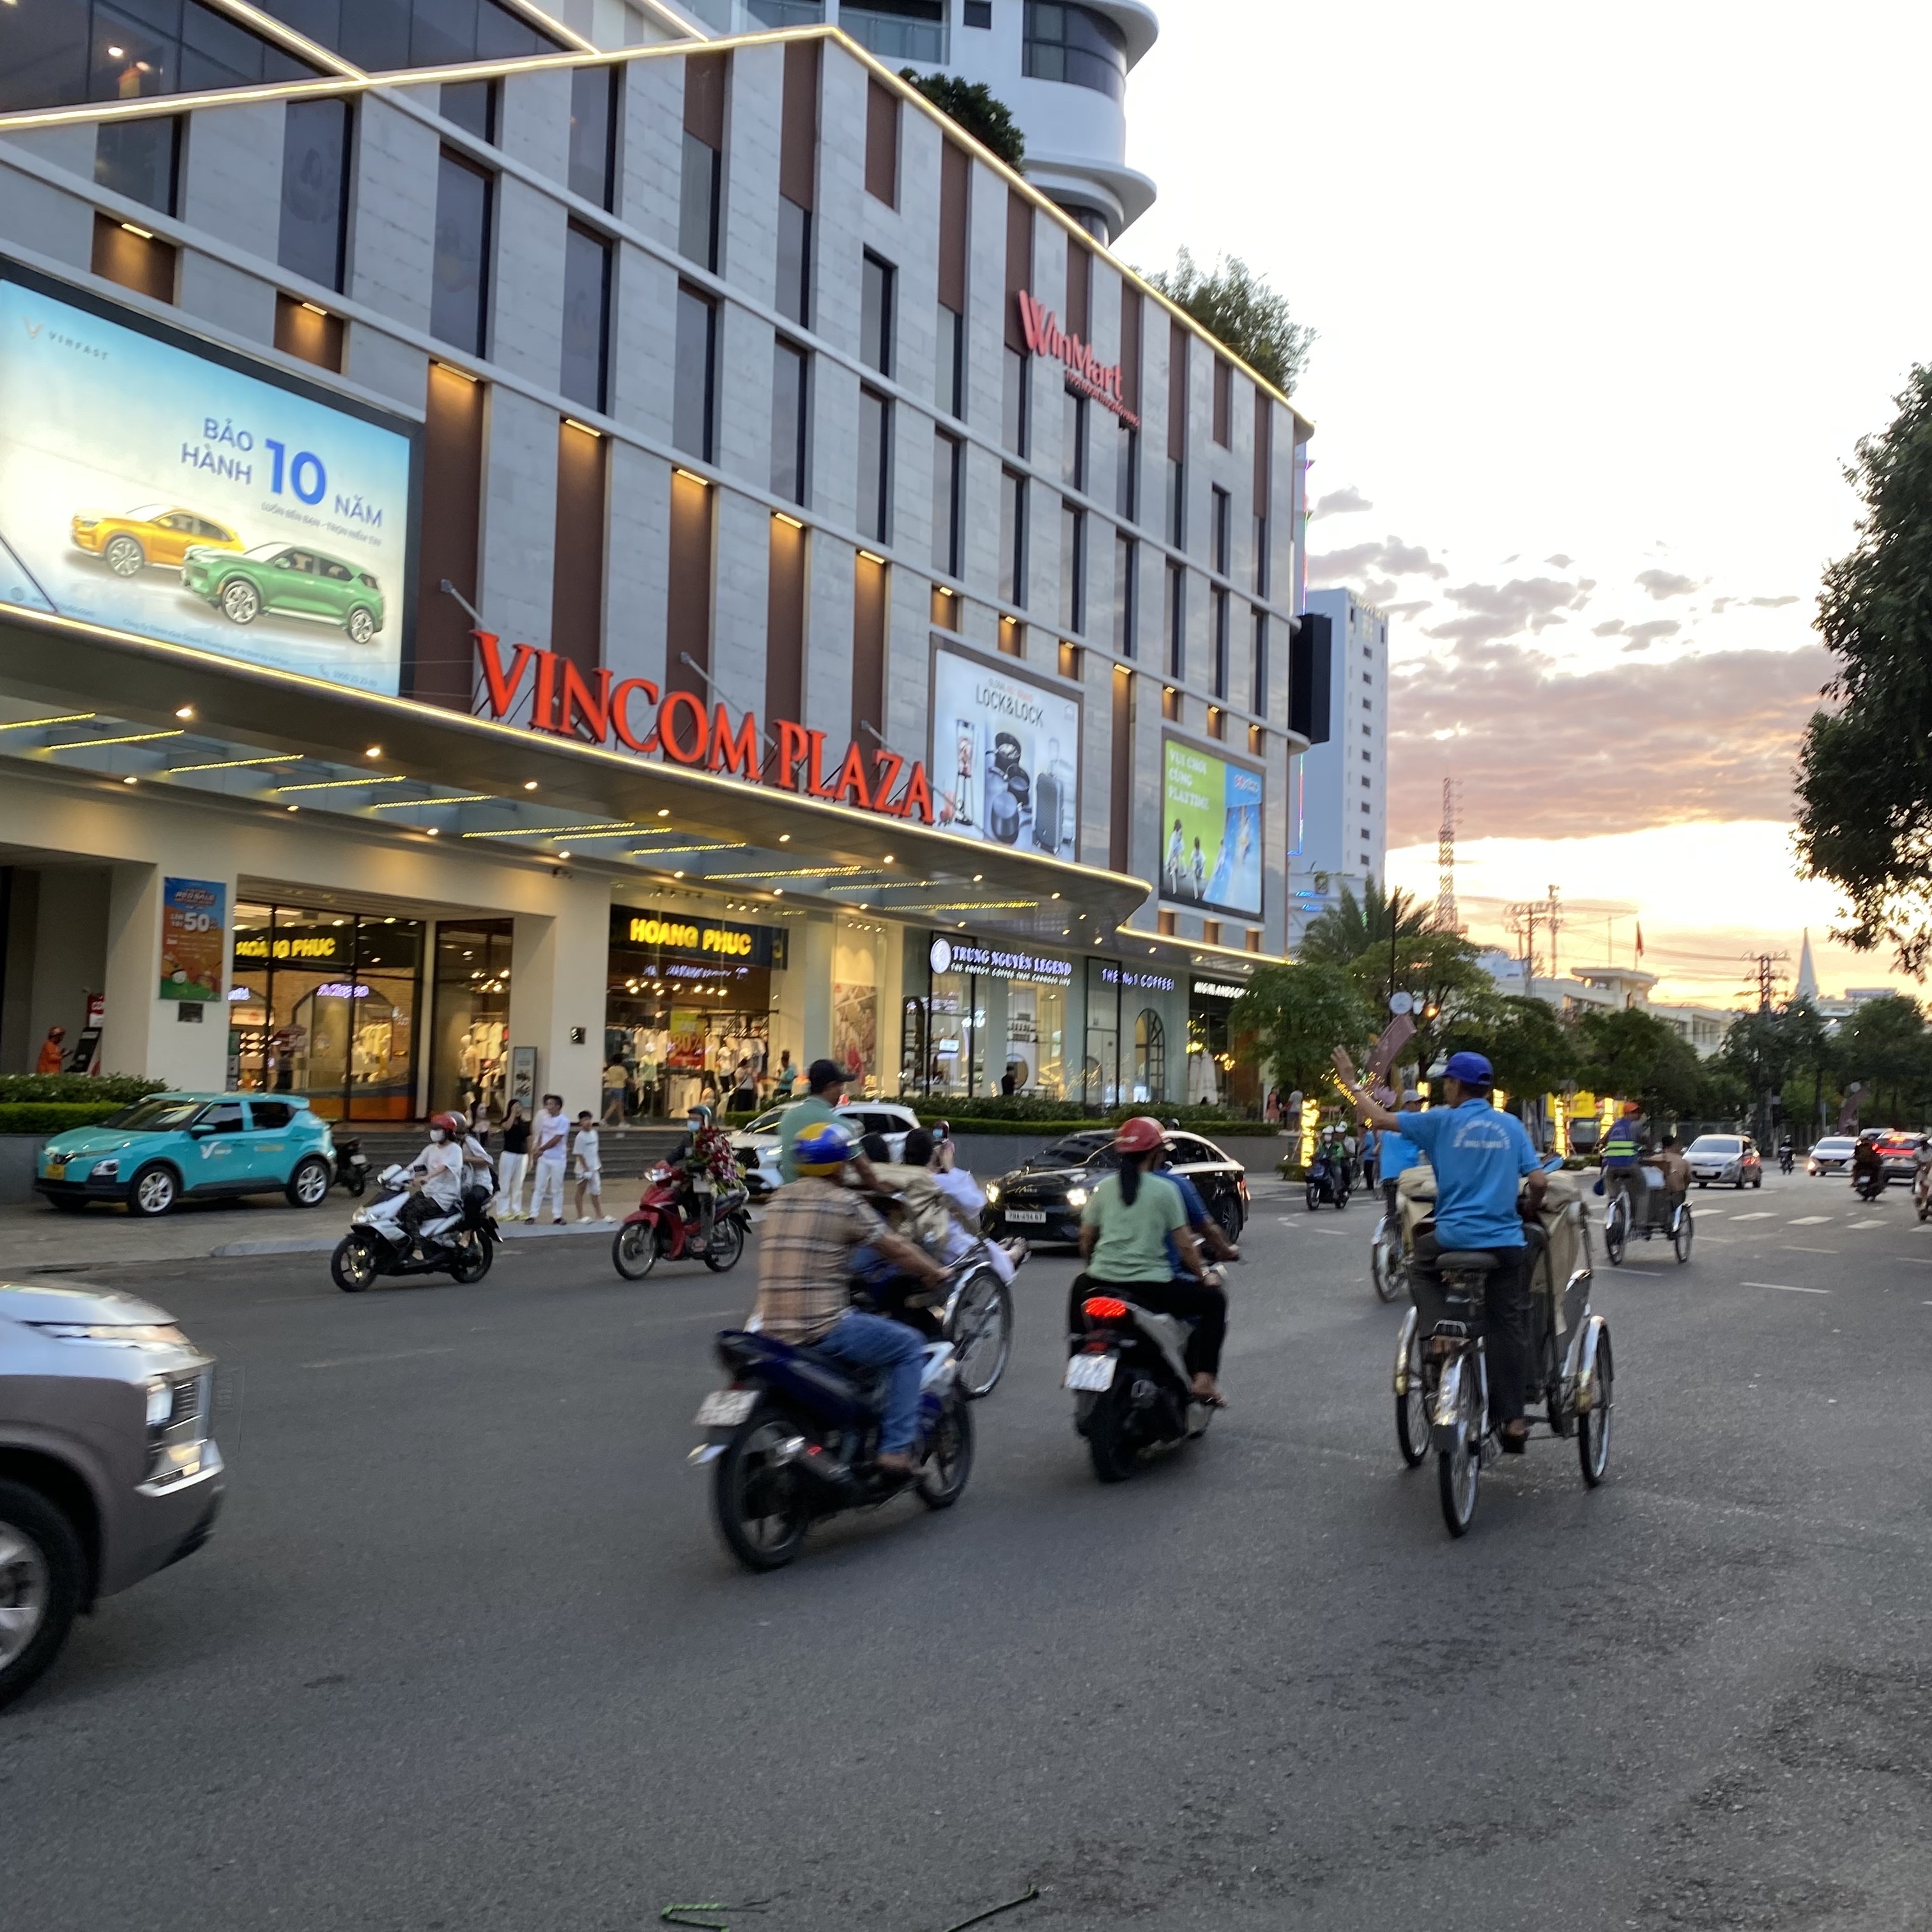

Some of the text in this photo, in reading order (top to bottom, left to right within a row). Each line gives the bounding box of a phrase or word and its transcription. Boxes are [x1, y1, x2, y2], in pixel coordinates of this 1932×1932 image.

[49, 330, 108, 360] VINFAST
[1019, 289, 1123, 401] WinMart
[203, 417, 254, 452] BẢO
[181, 441, 252, 485] HÀNH
[265, 438, 383, 528] 10 NĂM
[976, 683, 1043, 728] LOCK&LOCK
[468, 629, 935, 825] VINCOM PLAZA
[184, 912, 210, 932] 50
[630, 918, 752, 956] HOANG PHUC
[951, 962, 963, 972] THE
[952, 945, 990, 964] TRUNG
[1034, 957, 1072, 976] LEGEND
[1102, 968, 1118, 983] THE
